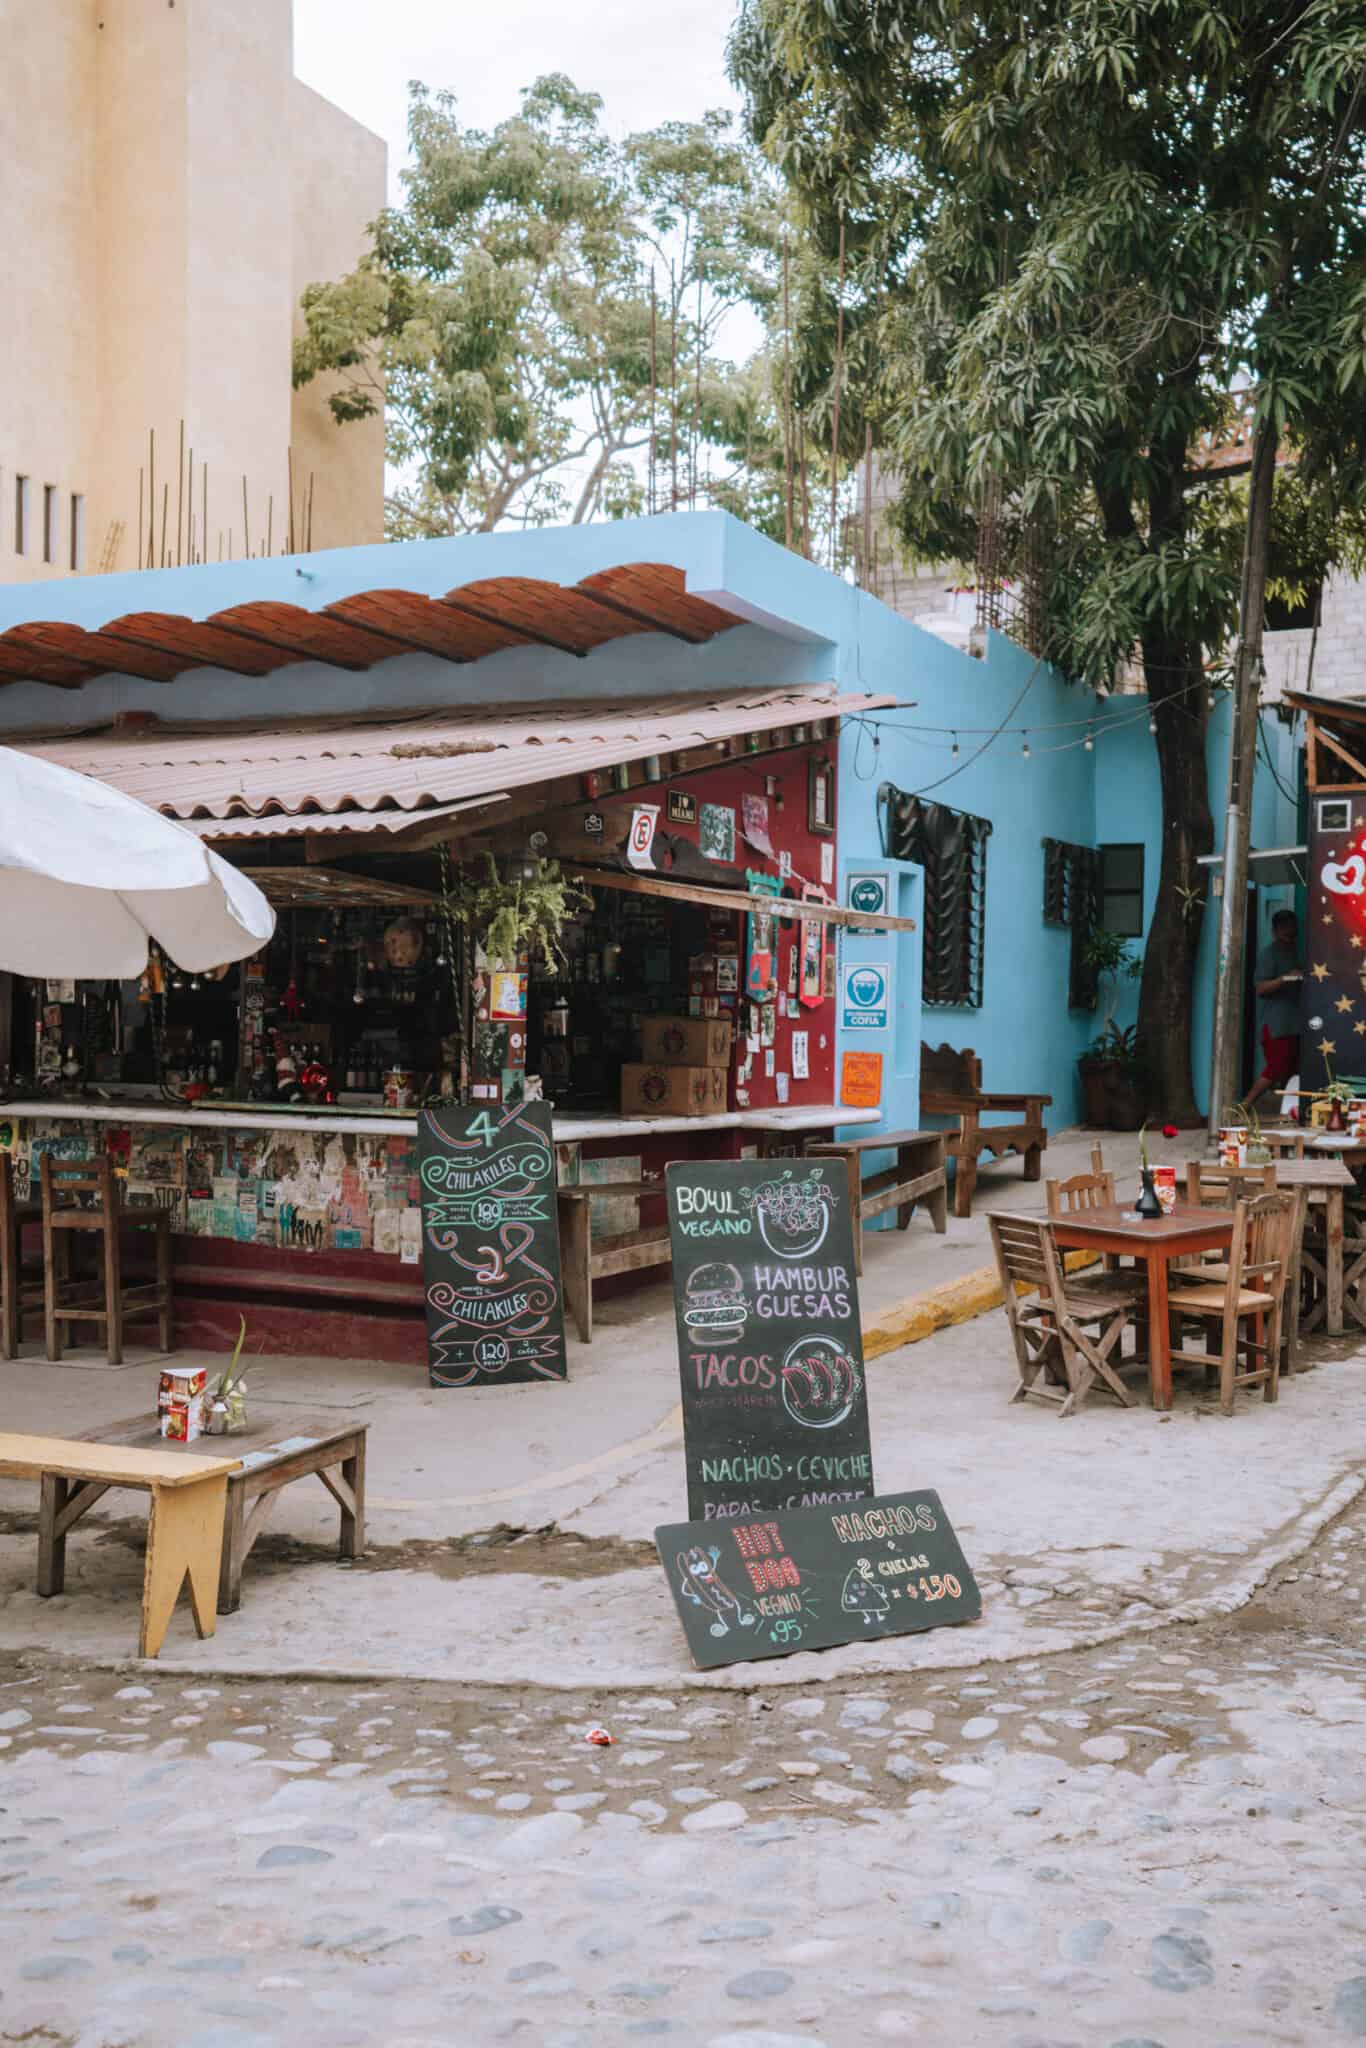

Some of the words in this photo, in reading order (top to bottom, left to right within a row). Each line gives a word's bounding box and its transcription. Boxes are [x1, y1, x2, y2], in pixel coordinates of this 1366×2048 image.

[850, 1016, 881, 1026] COFIA
[465, 1111, 500, 1147] 4
[446, 1154, 517, 1190] CHILAKILES
[477, 1202, 499, 1220] 180
[678, 1217, 752, 1237] VEGANO
[477, 1246, 508, 1282] 2
[754, 1265, 850, 1292] HAMBUR
[451, 1293, 528, 1321] CHILAKILES
[756, 1294, 851, 1319] GUESAS
[481, 1343, 506, 1360] 120
[689, 1354, 777, 1390] TACOS
[701, 1453, 784, 1483] NACHOS
[796, 1454, 872, 1481] CEVICHE
[703, 1500, 762, 1521] PAPAS
[831, 1503, 937, 1544] NACHOS
[732, 1521, 785, 1558] HOT
[745, 1556, 801, 1593] DOG
[856, 1557, 875, 1580] 2
[877, 1554, 930, 1576] CHELAS
[752, 1592, 802, 1617] VEGANO
